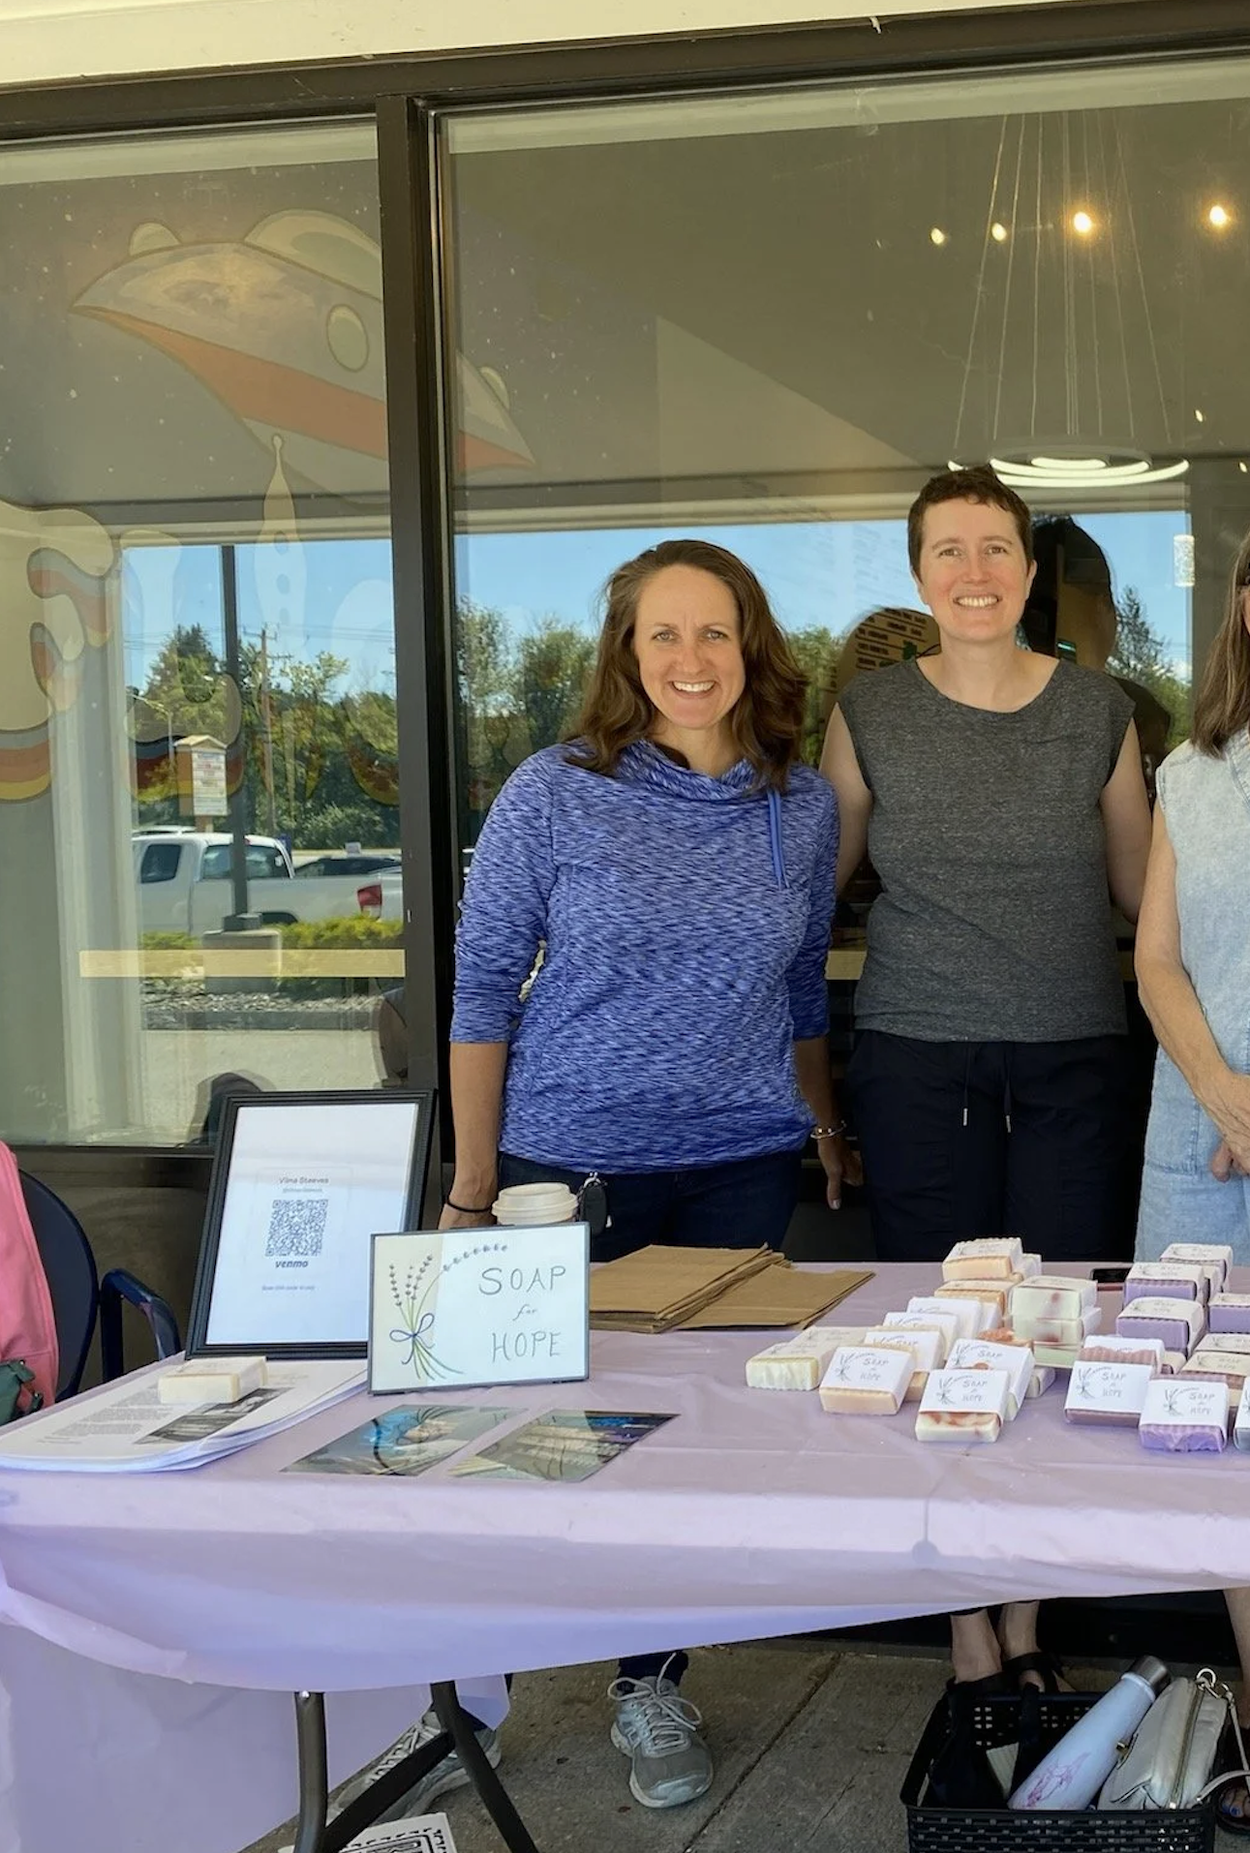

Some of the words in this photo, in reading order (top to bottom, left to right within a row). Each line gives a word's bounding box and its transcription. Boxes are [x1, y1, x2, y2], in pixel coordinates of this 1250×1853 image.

[275, 1260, 309, 1269] venmo
[479, 1265, 566, 1295] SOAP
[512, 1303, 538, 1322] for
[491, 1330, 561, 1363] HOPE
